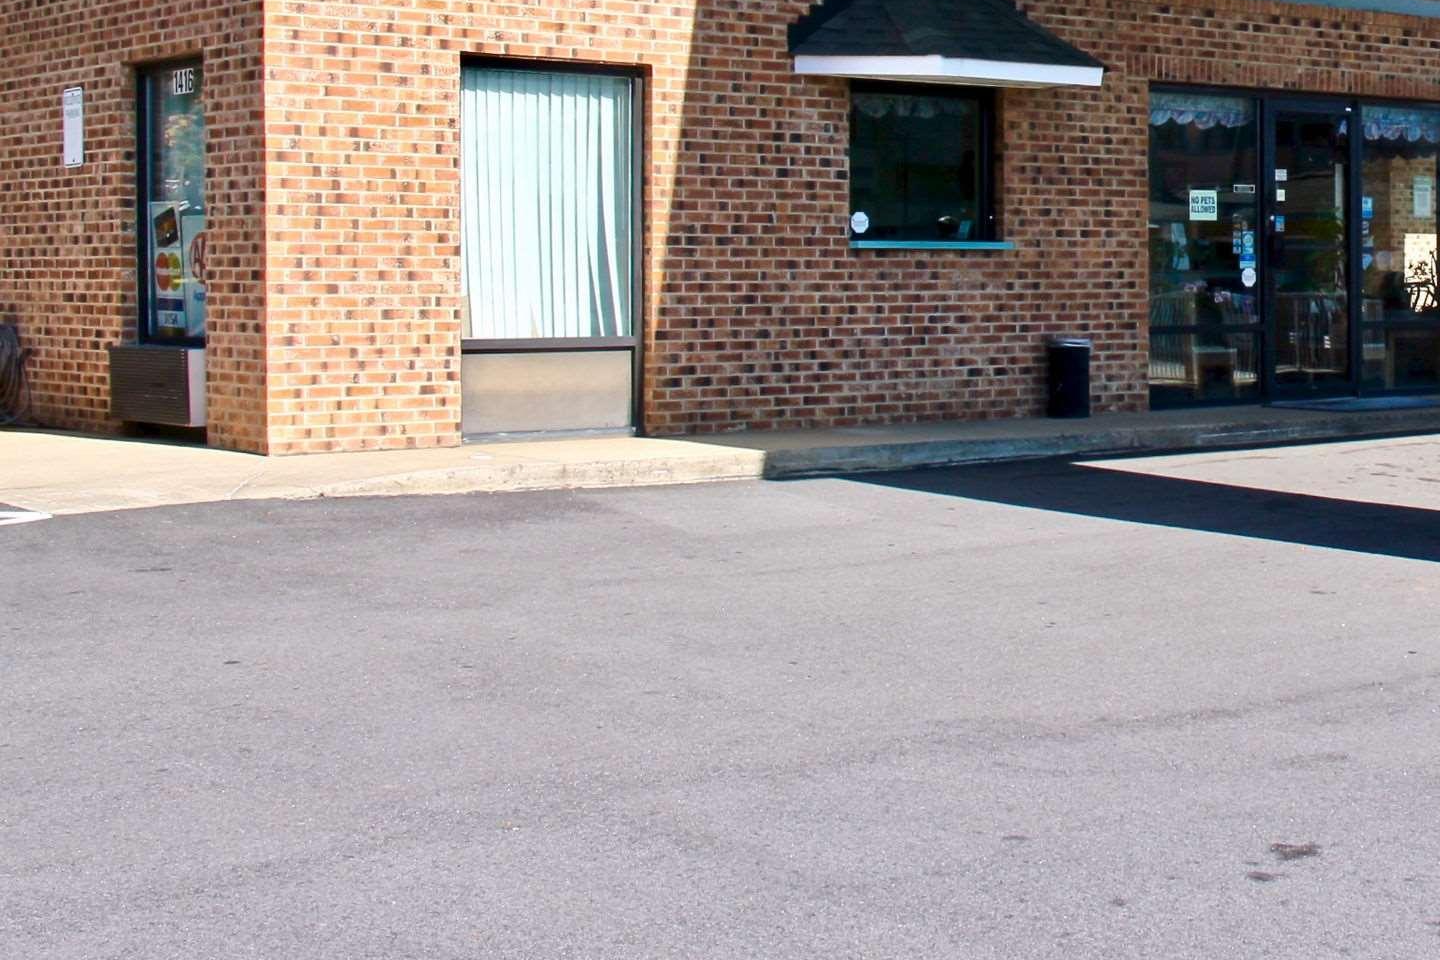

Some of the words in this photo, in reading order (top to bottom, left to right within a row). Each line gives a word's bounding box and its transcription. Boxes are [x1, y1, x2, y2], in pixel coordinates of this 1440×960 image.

[174, 69, 194, 94] 1416
[1191, 196, 1200, 205] NO
[1200, 196, 1216, 205] PETS
